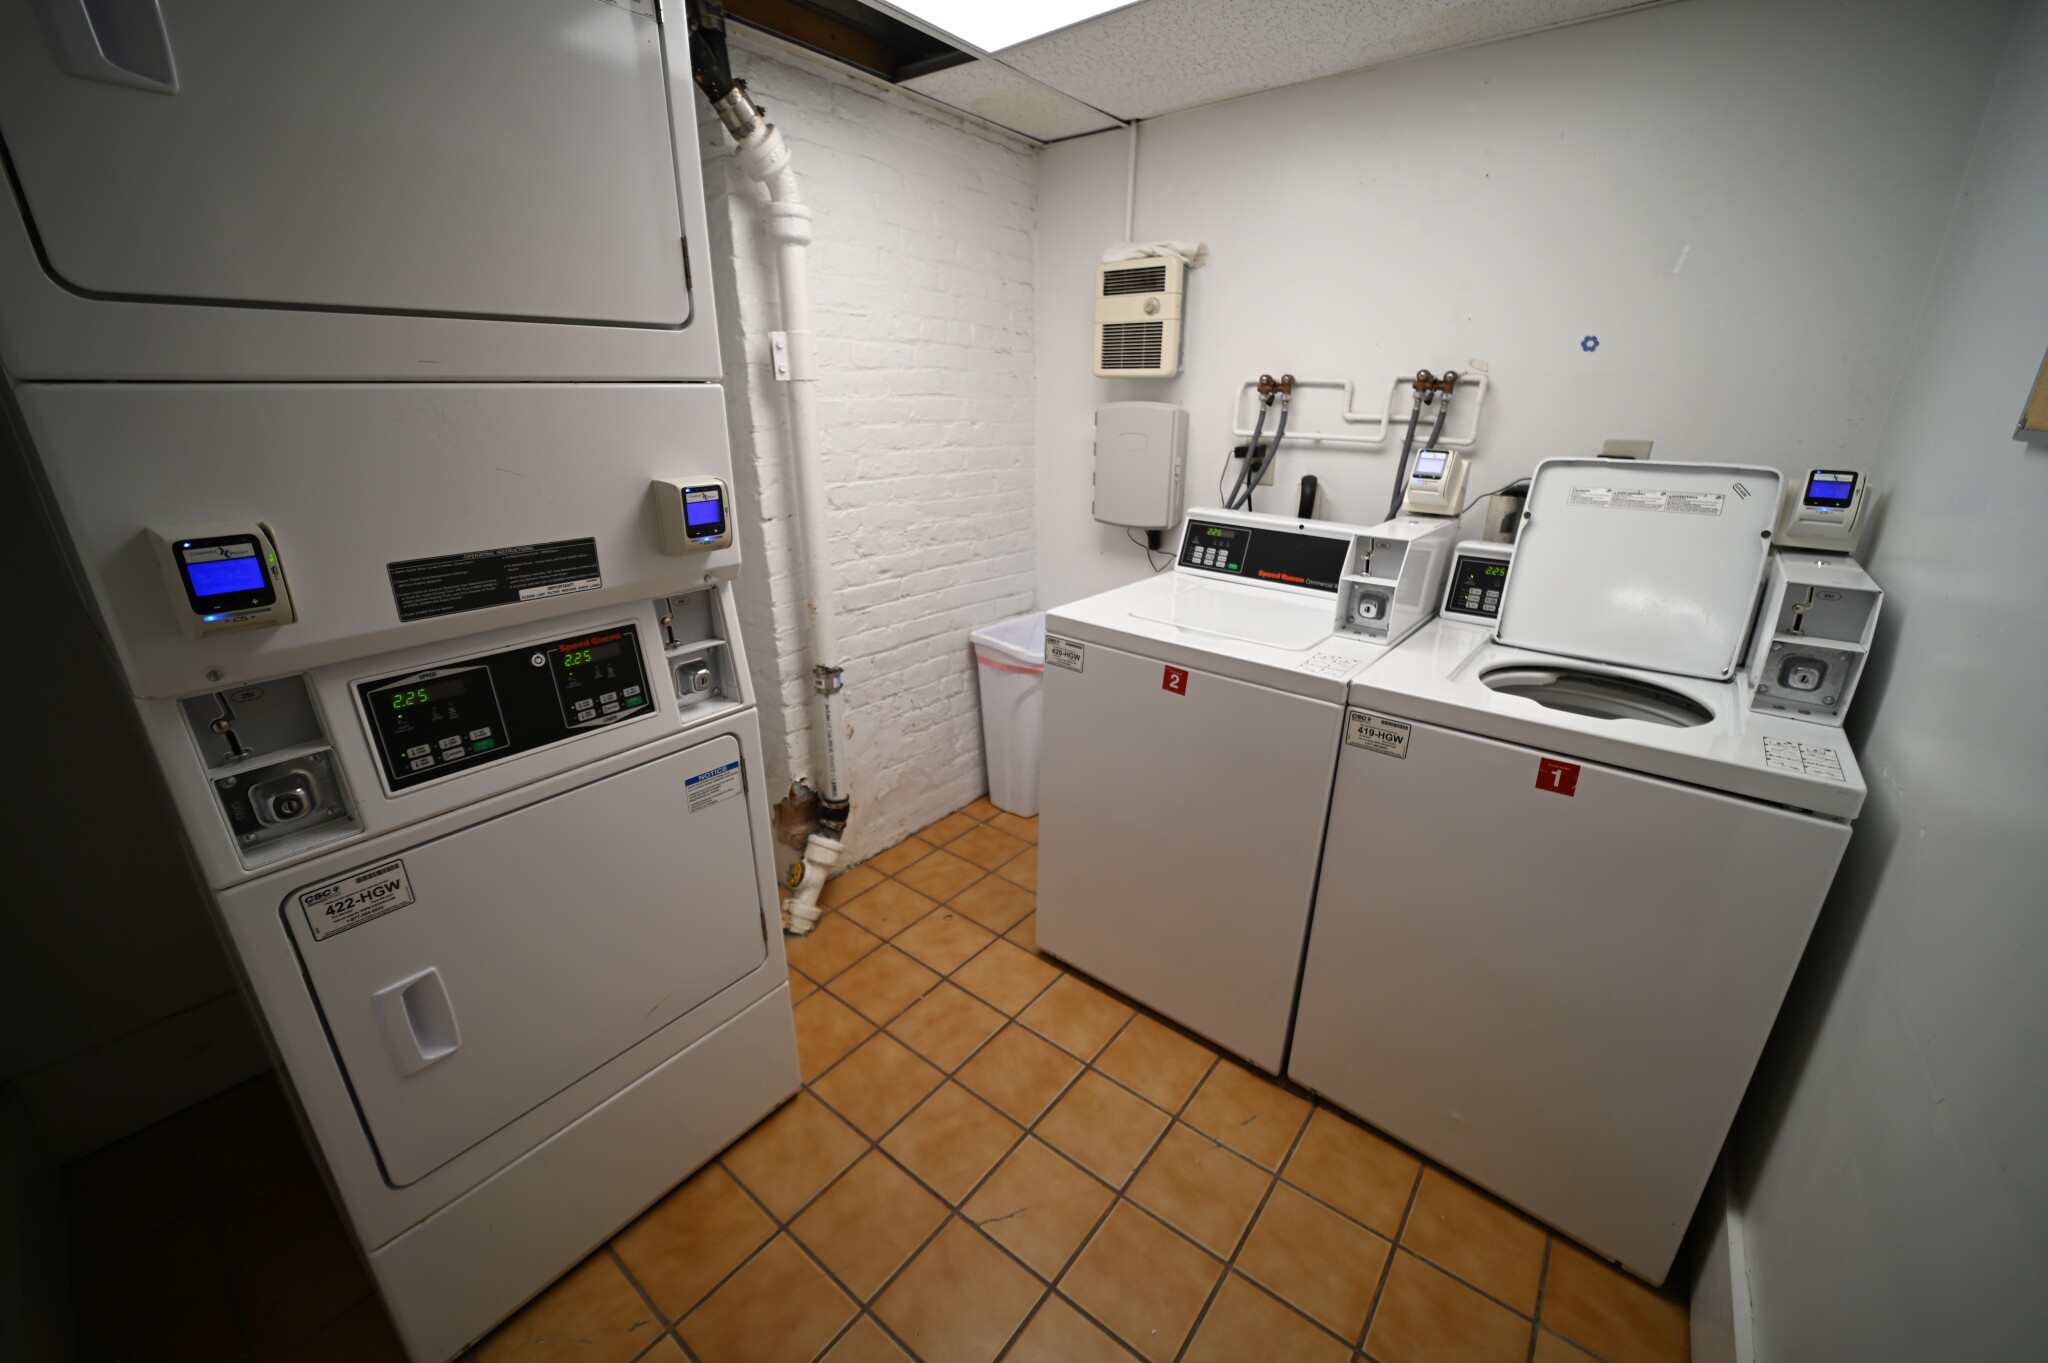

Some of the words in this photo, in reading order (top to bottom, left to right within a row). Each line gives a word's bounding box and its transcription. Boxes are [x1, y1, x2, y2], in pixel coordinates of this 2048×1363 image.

[463, 551, 494, 559] OPERATING
[495, 545, 534, 554] INSTRUCTIONS
[1257, 569, 1281, 580] Speed
[1281, 573, 1305, 584] Queen
[1485, 566, 1506, 577] 2.25
[559, 637, 591, 653] Speed
[591, 632, 622, 646] Queen
[564, 649, 592, 668] 2.25
[1051, 648, 1081, 661] 420-HGW
[418, 671, 437, 680] UPPER
[1169, 674, 1181, 689] 2
[392, 688, 429, 709] 2.25
[1352, 713, 1367, 721] CSC
[1357, 726, 1404, 744] 419-HGW
[698, 765, 728, 781] NOTICE
[1551, 769, 1562, 788] 1
[304, 889, 331, 903] CSC
[325, 879, 401, 916] 422-HGW
